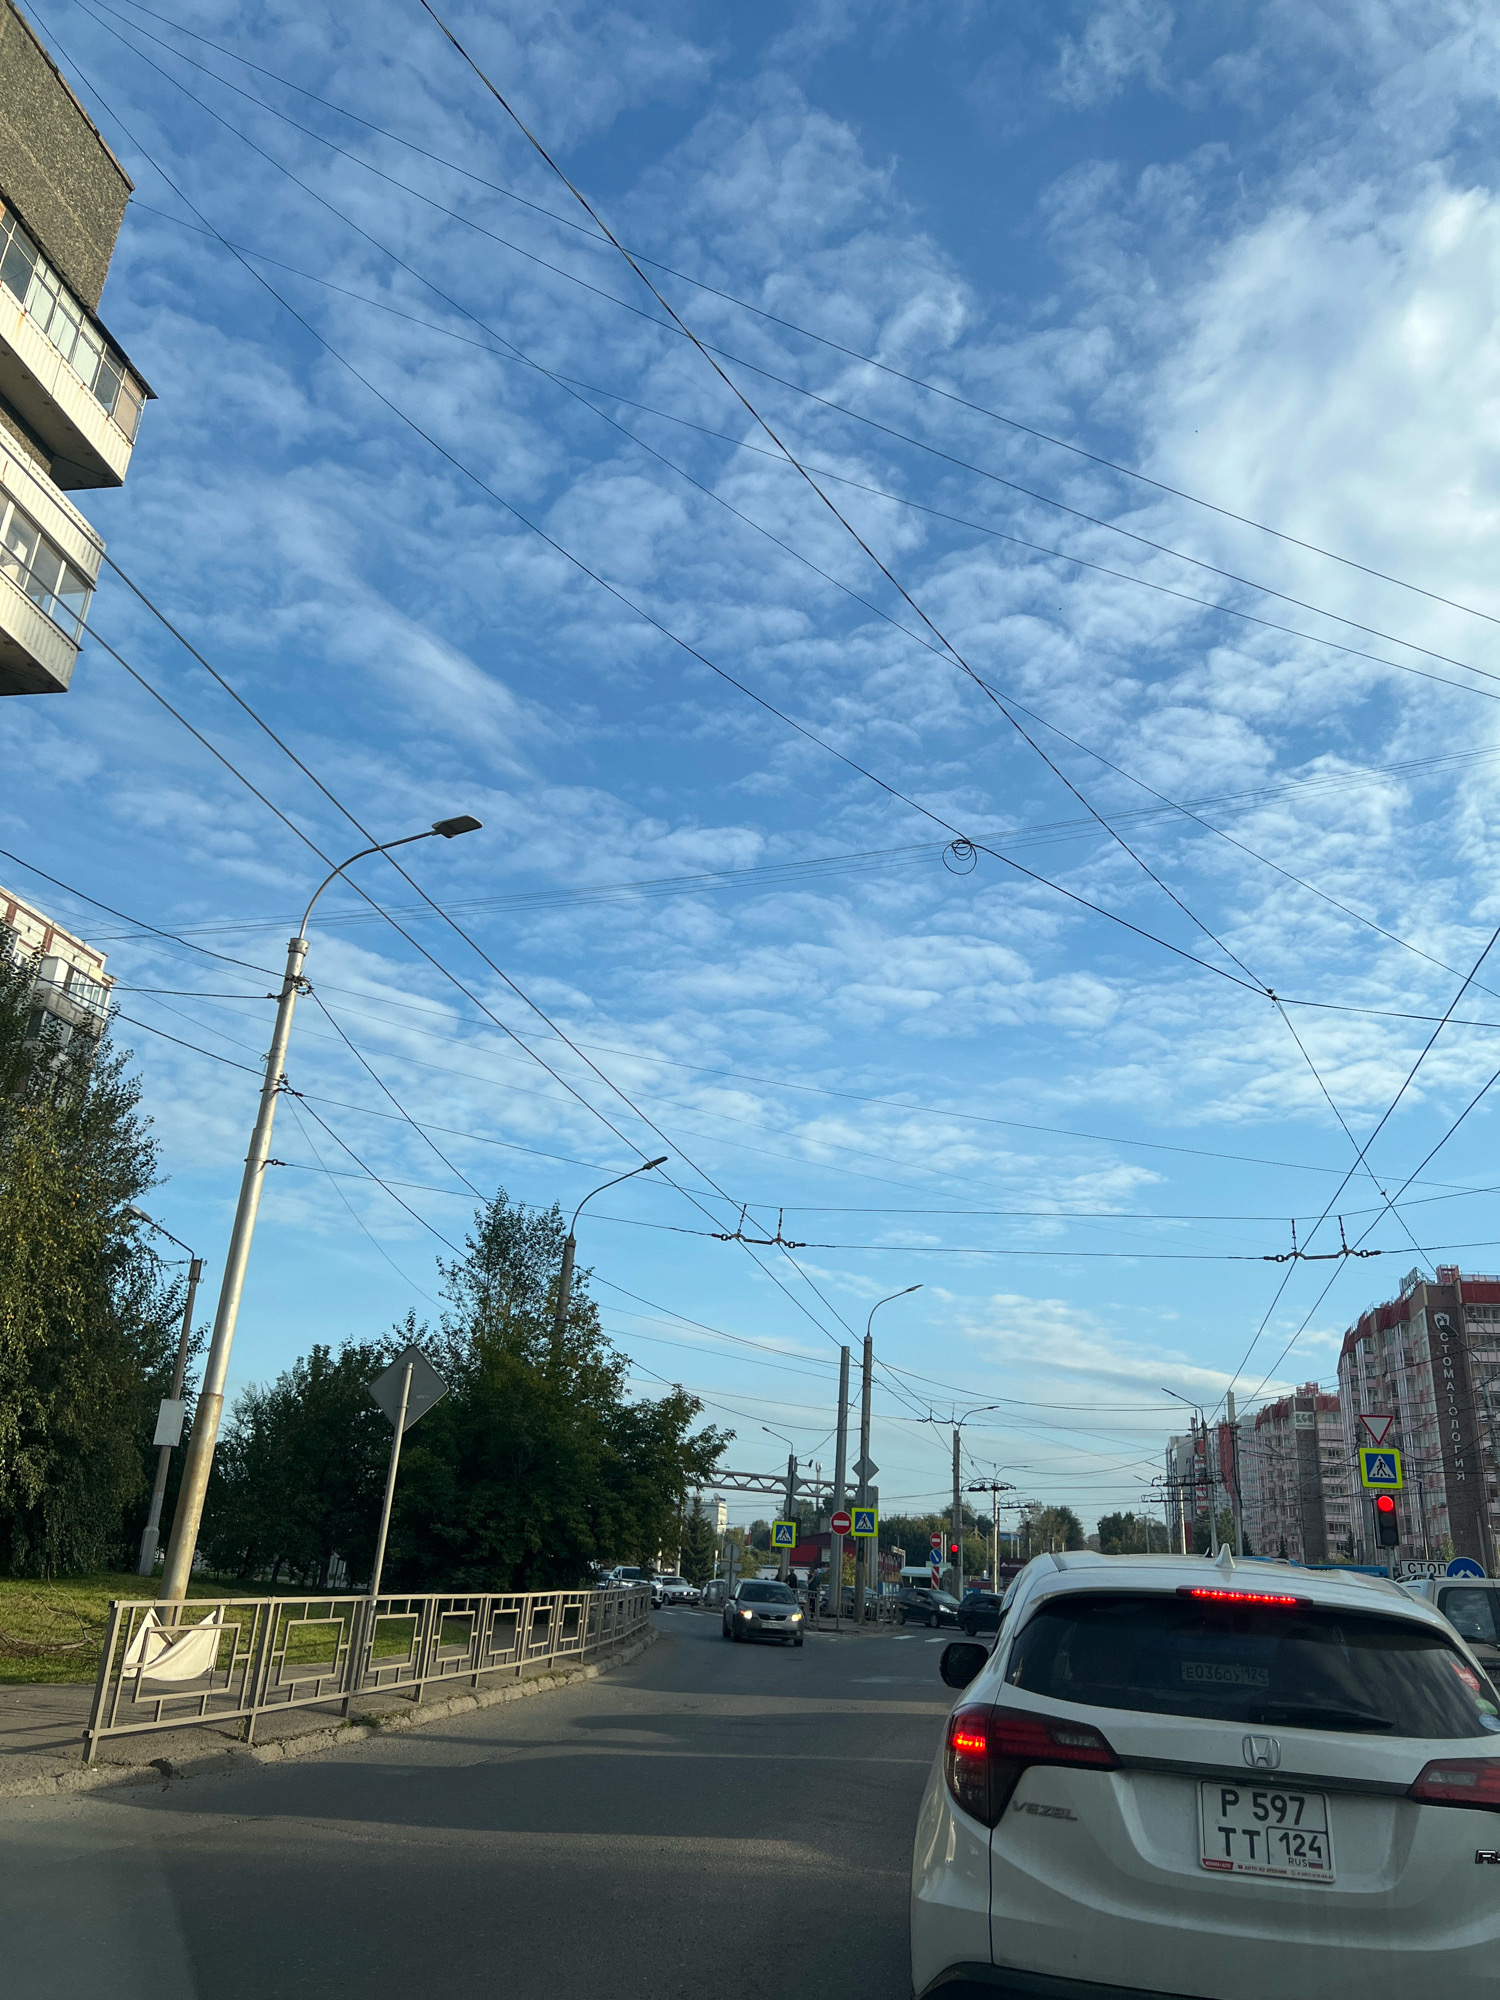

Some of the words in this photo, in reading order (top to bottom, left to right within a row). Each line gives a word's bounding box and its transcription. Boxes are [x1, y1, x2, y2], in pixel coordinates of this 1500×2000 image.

[1439, 1332, 1466, 1481] СТОМАТОЛОГИЯ
[1012, 1800, 1079, 1821] VEZEL
[1252, 1791, 1306, 1826] 597
[1278, 1831, 1322, 1859] 124
[1288, 1857, 1308, 1868] RUS
